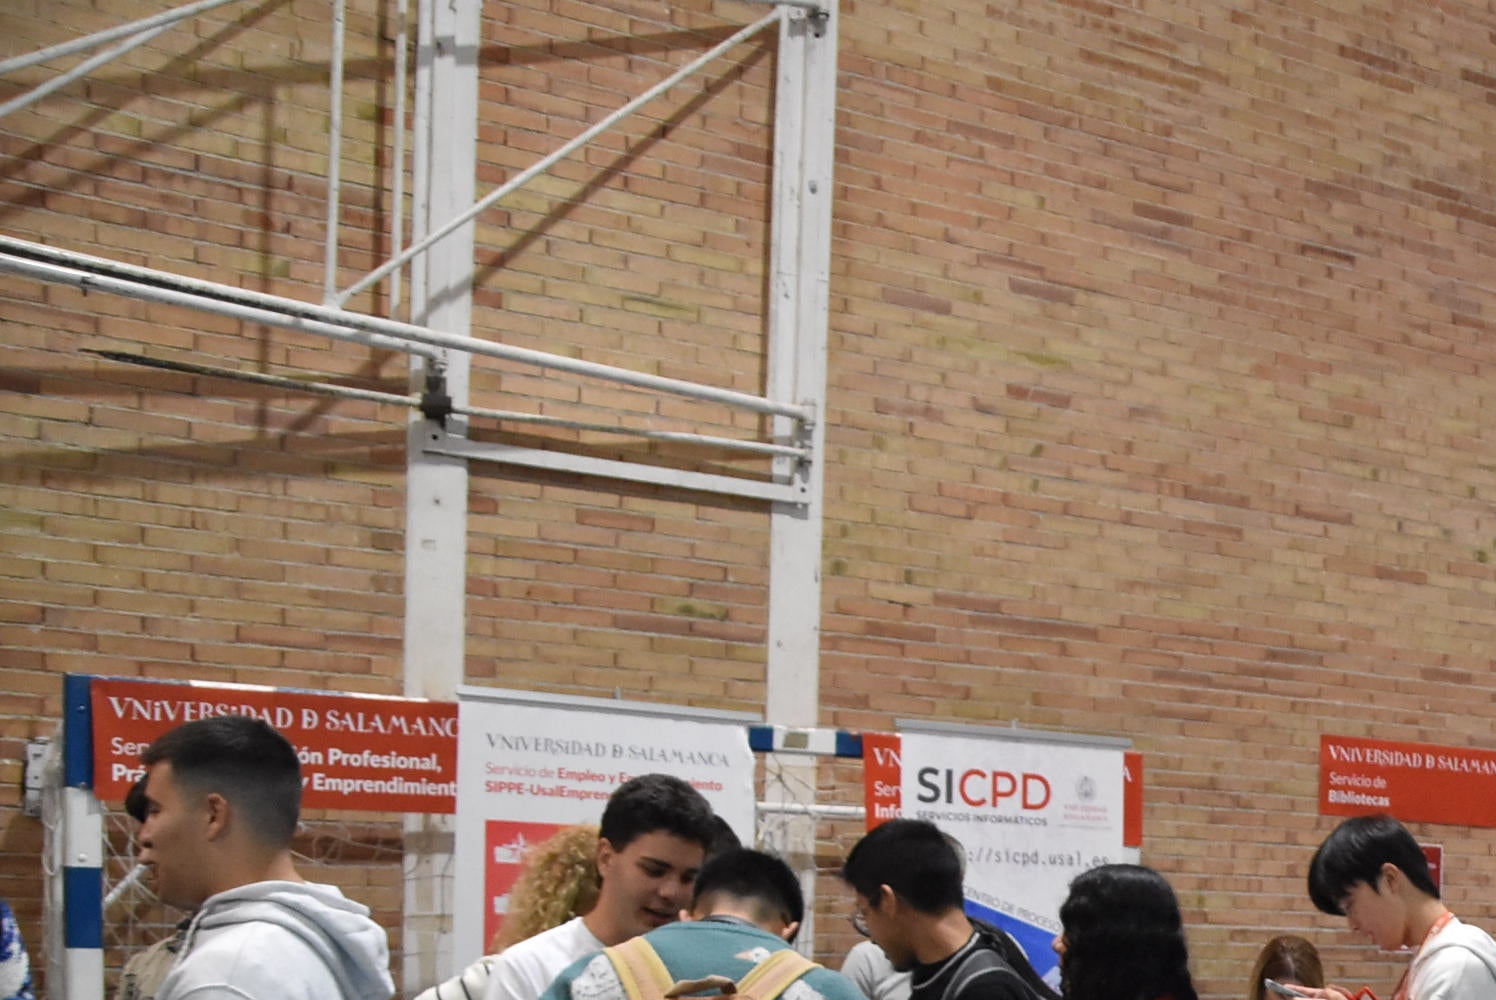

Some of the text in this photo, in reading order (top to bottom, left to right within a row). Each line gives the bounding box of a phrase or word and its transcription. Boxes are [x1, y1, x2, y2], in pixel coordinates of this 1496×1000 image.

[325, 709, 459, 738] SALAMANC
[328, 748, 443, 773] Profesional,
[628, 745, 730, 767] SALAMANCA
[485, 761, 536, 777] Servicio
[539, 766, 555, 778] de
[557, 766, 606, 783] Empleo
[608, 773, 616, 784] y
[1329, 771, 1387, 790] Servicio de
[312, 773, 459, 797] Emprendimient
[916, 766, 1052, 811] SICPD
[1328, 790, 1390, 807] Bibliotecas
[916, 809, 972, 823] SERVICIOS
